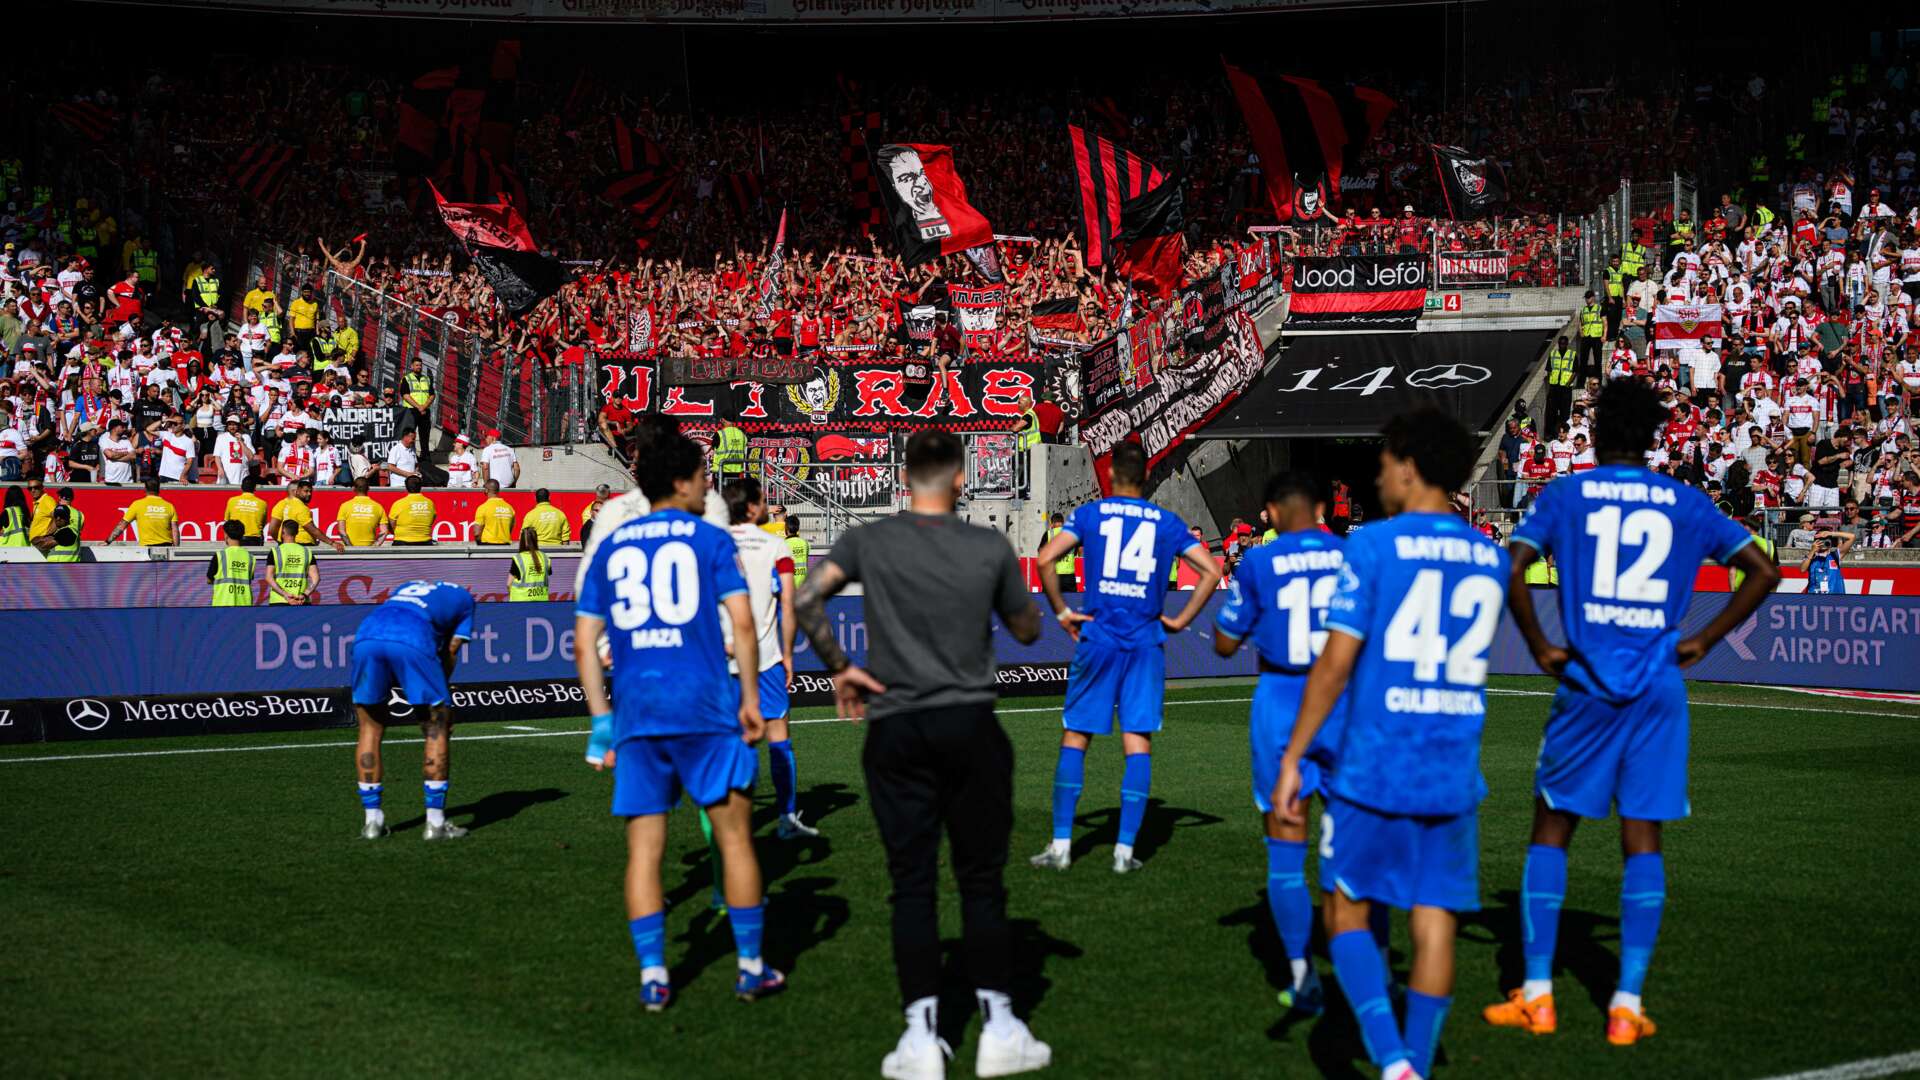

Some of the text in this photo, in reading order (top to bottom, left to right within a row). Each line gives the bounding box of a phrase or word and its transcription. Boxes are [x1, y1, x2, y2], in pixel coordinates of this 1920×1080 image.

[924, 224, 947, 236] UL
[1294, 261, 1426, 288] Jood Jeföl
[1441, 258, 1506, 275] DJANGOS
[1447, 295, 1457, 310] 4
[323, 407, 394, 424] ANDRICH
[374, 422, 395, 439] ICH
[362, 440, 399, 459] TRIK
[1582, 480, 1677, 506] BAYER 04
[411, 503, 429, 511] SDS
[1099, 503, 1141, 519] BAYER
[612, 520, 668, 544] BAYER
[1099, 516, 1157, 583] 14
[1395, 536, 1471, 565] BAYER
[1586, 505, 1673, 603] 12
[607, 541, 700, 630] 30
[1099, 579, 1147, 599] SCHICK
[1384, 568, 1504, 686] 42
[1583, 602, 1665, 629] TAPSOBA
[1769, 604, 1920, 635] STUTTGART
[631, 628, 682, 650] MAZA
[1769, 636, 1886, 666] AIRPORT
[450, 683, 611, 707] ercedes-Be
[120, 695, 333, 722] Mercedes-Benz
